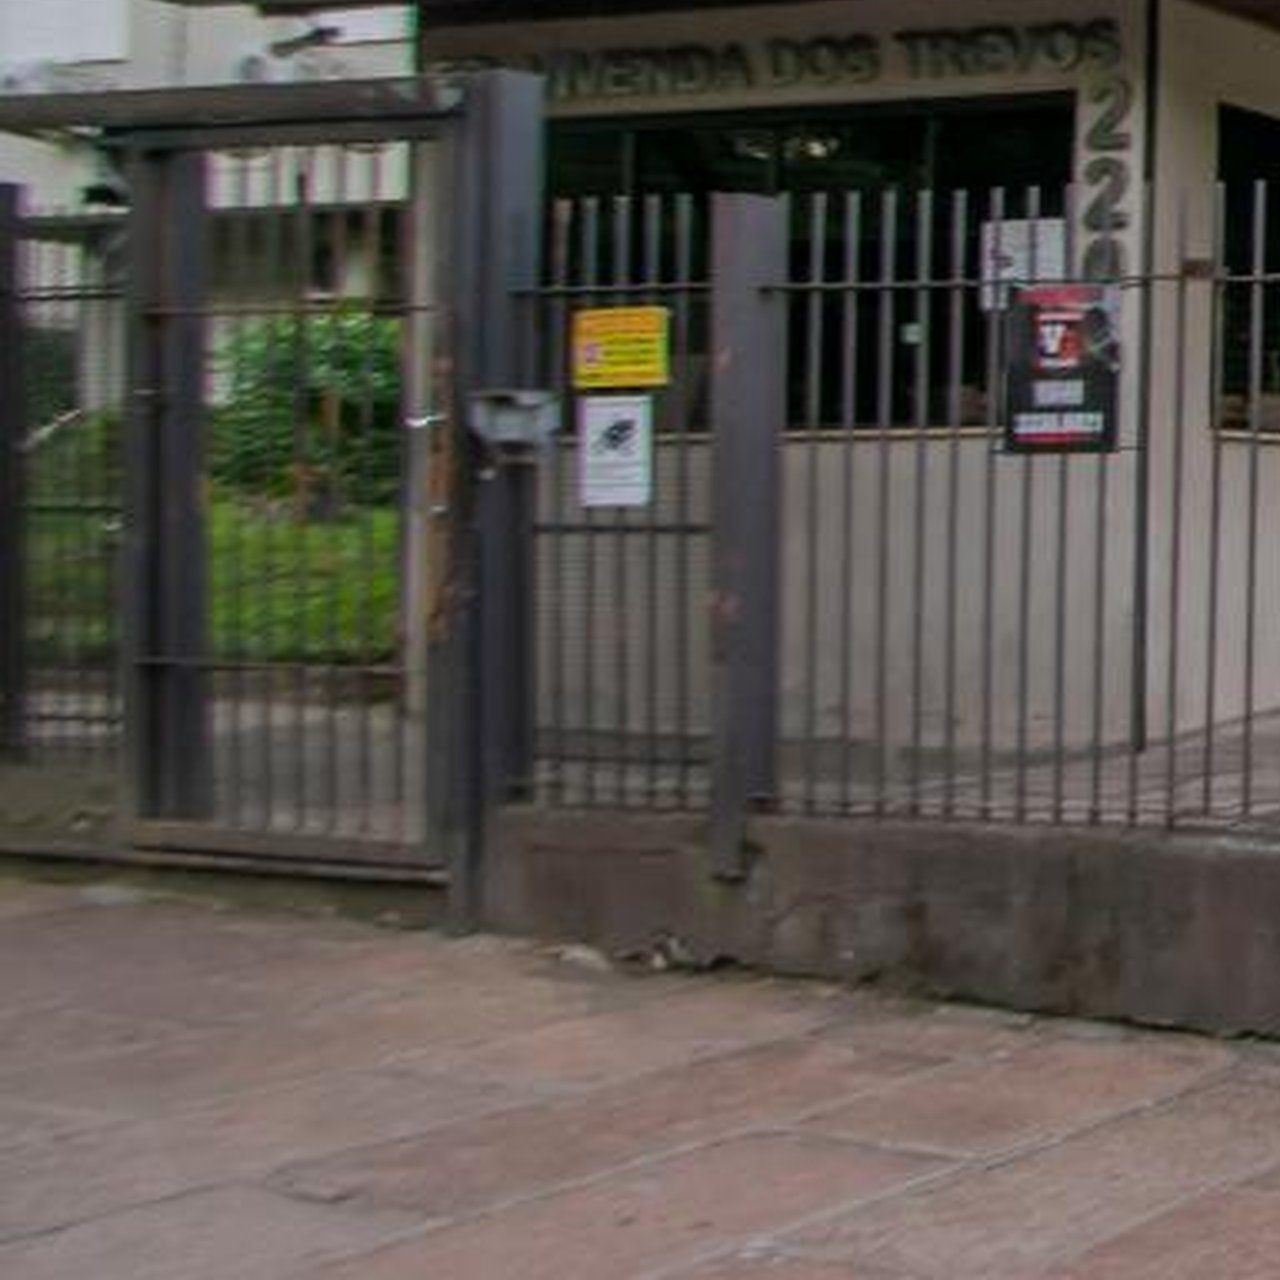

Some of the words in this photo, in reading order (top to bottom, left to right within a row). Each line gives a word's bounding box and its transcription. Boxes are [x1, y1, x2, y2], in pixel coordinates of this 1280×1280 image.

[522, 42, 756, 100] IVENDA
[766, 34, 883, 86] DOS
[891, 17, 1122, 81] TREVOS
